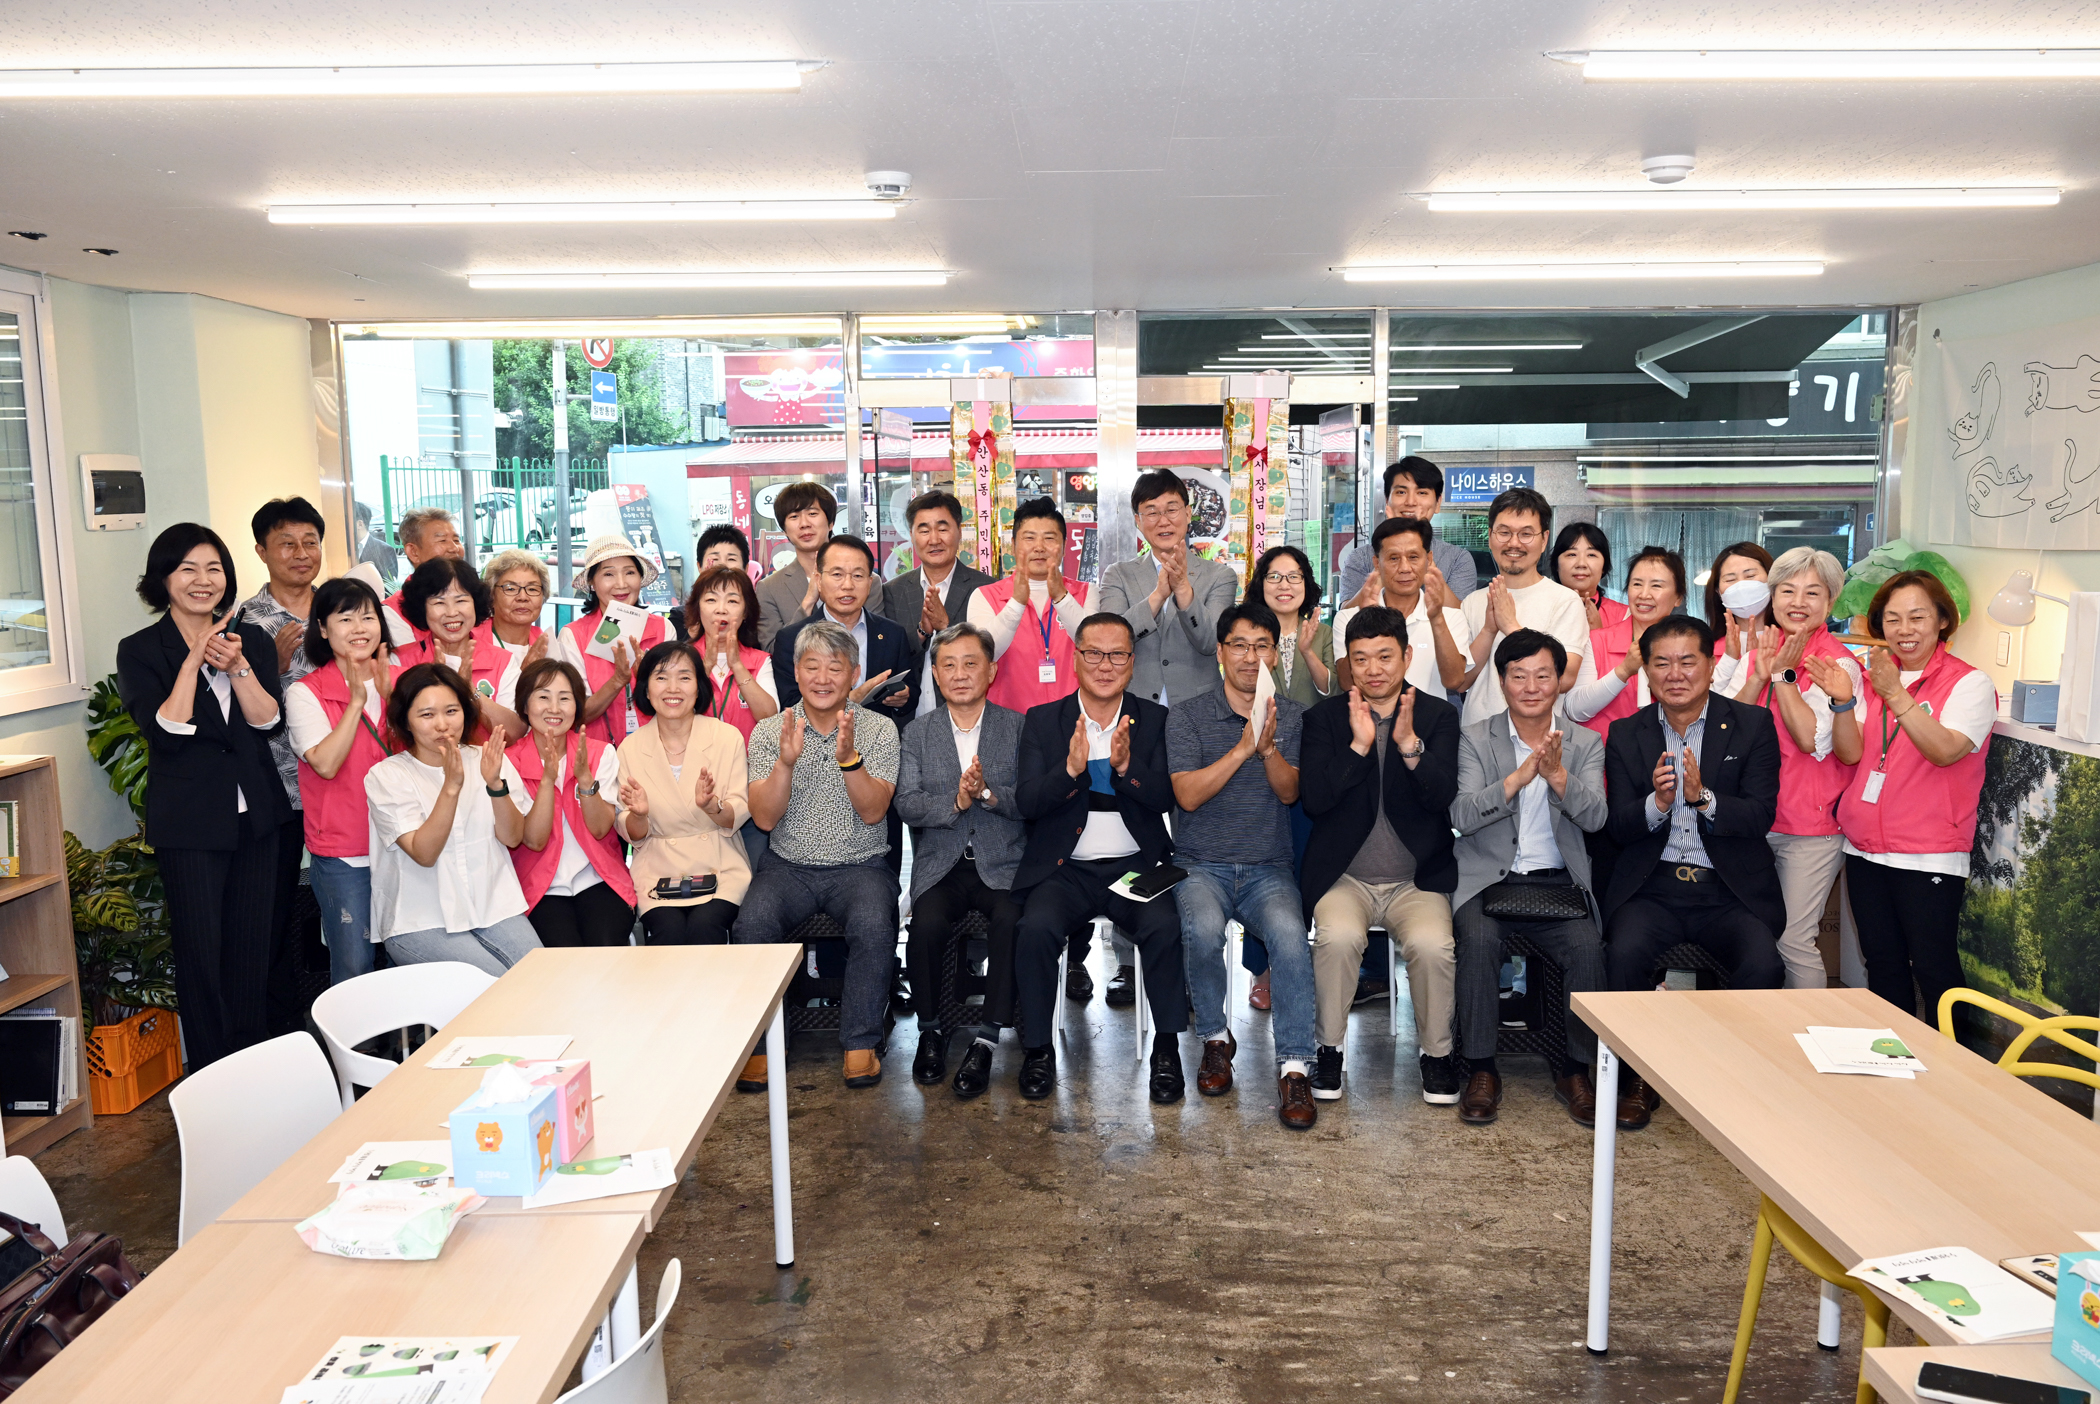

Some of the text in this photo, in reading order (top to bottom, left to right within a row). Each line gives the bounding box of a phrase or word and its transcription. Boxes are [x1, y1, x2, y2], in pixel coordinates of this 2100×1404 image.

[593, 405, 616, 417] 일방통행
[976, 446, 988, 496] 안산동
[1254, 459, 1266, 511] 시장님
[1451, 473, 1527, 489] 나이스하우스
